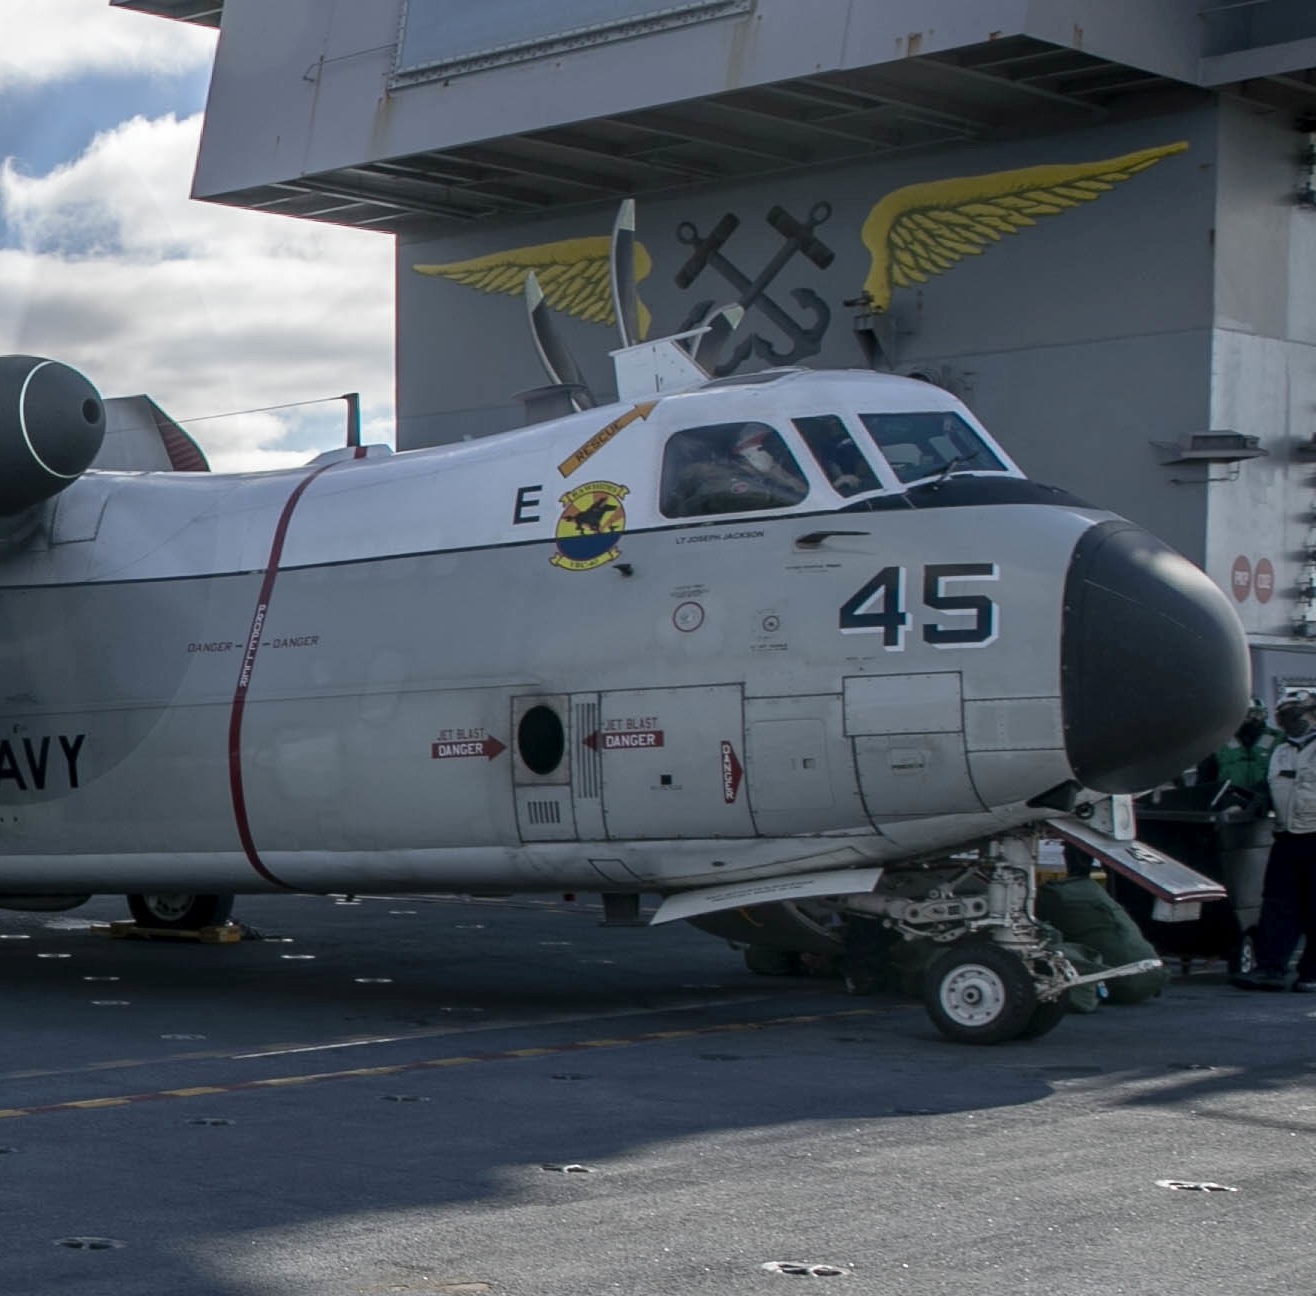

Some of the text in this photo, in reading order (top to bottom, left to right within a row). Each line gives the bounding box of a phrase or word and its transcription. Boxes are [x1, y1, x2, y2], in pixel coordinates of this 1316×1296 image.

[513, 485, 543, 524] E
[687, 534, 721, 543] JOSEPH
[723, 530, 764, 541] JACKSON
[839, 563, 1000, 651] 45
[187, 635, 320, 653] DANGER DANGER
[239, 604, 267, 688] PROPELLER
[604, 717, 657, 731] JET BLAST
[437, 727, 485, 740] JET BLAST
[606, 733, 655, 747] DANGER
[438, 743, 483, 757] DANGER
[722, 744, 734, 799] DANGER
